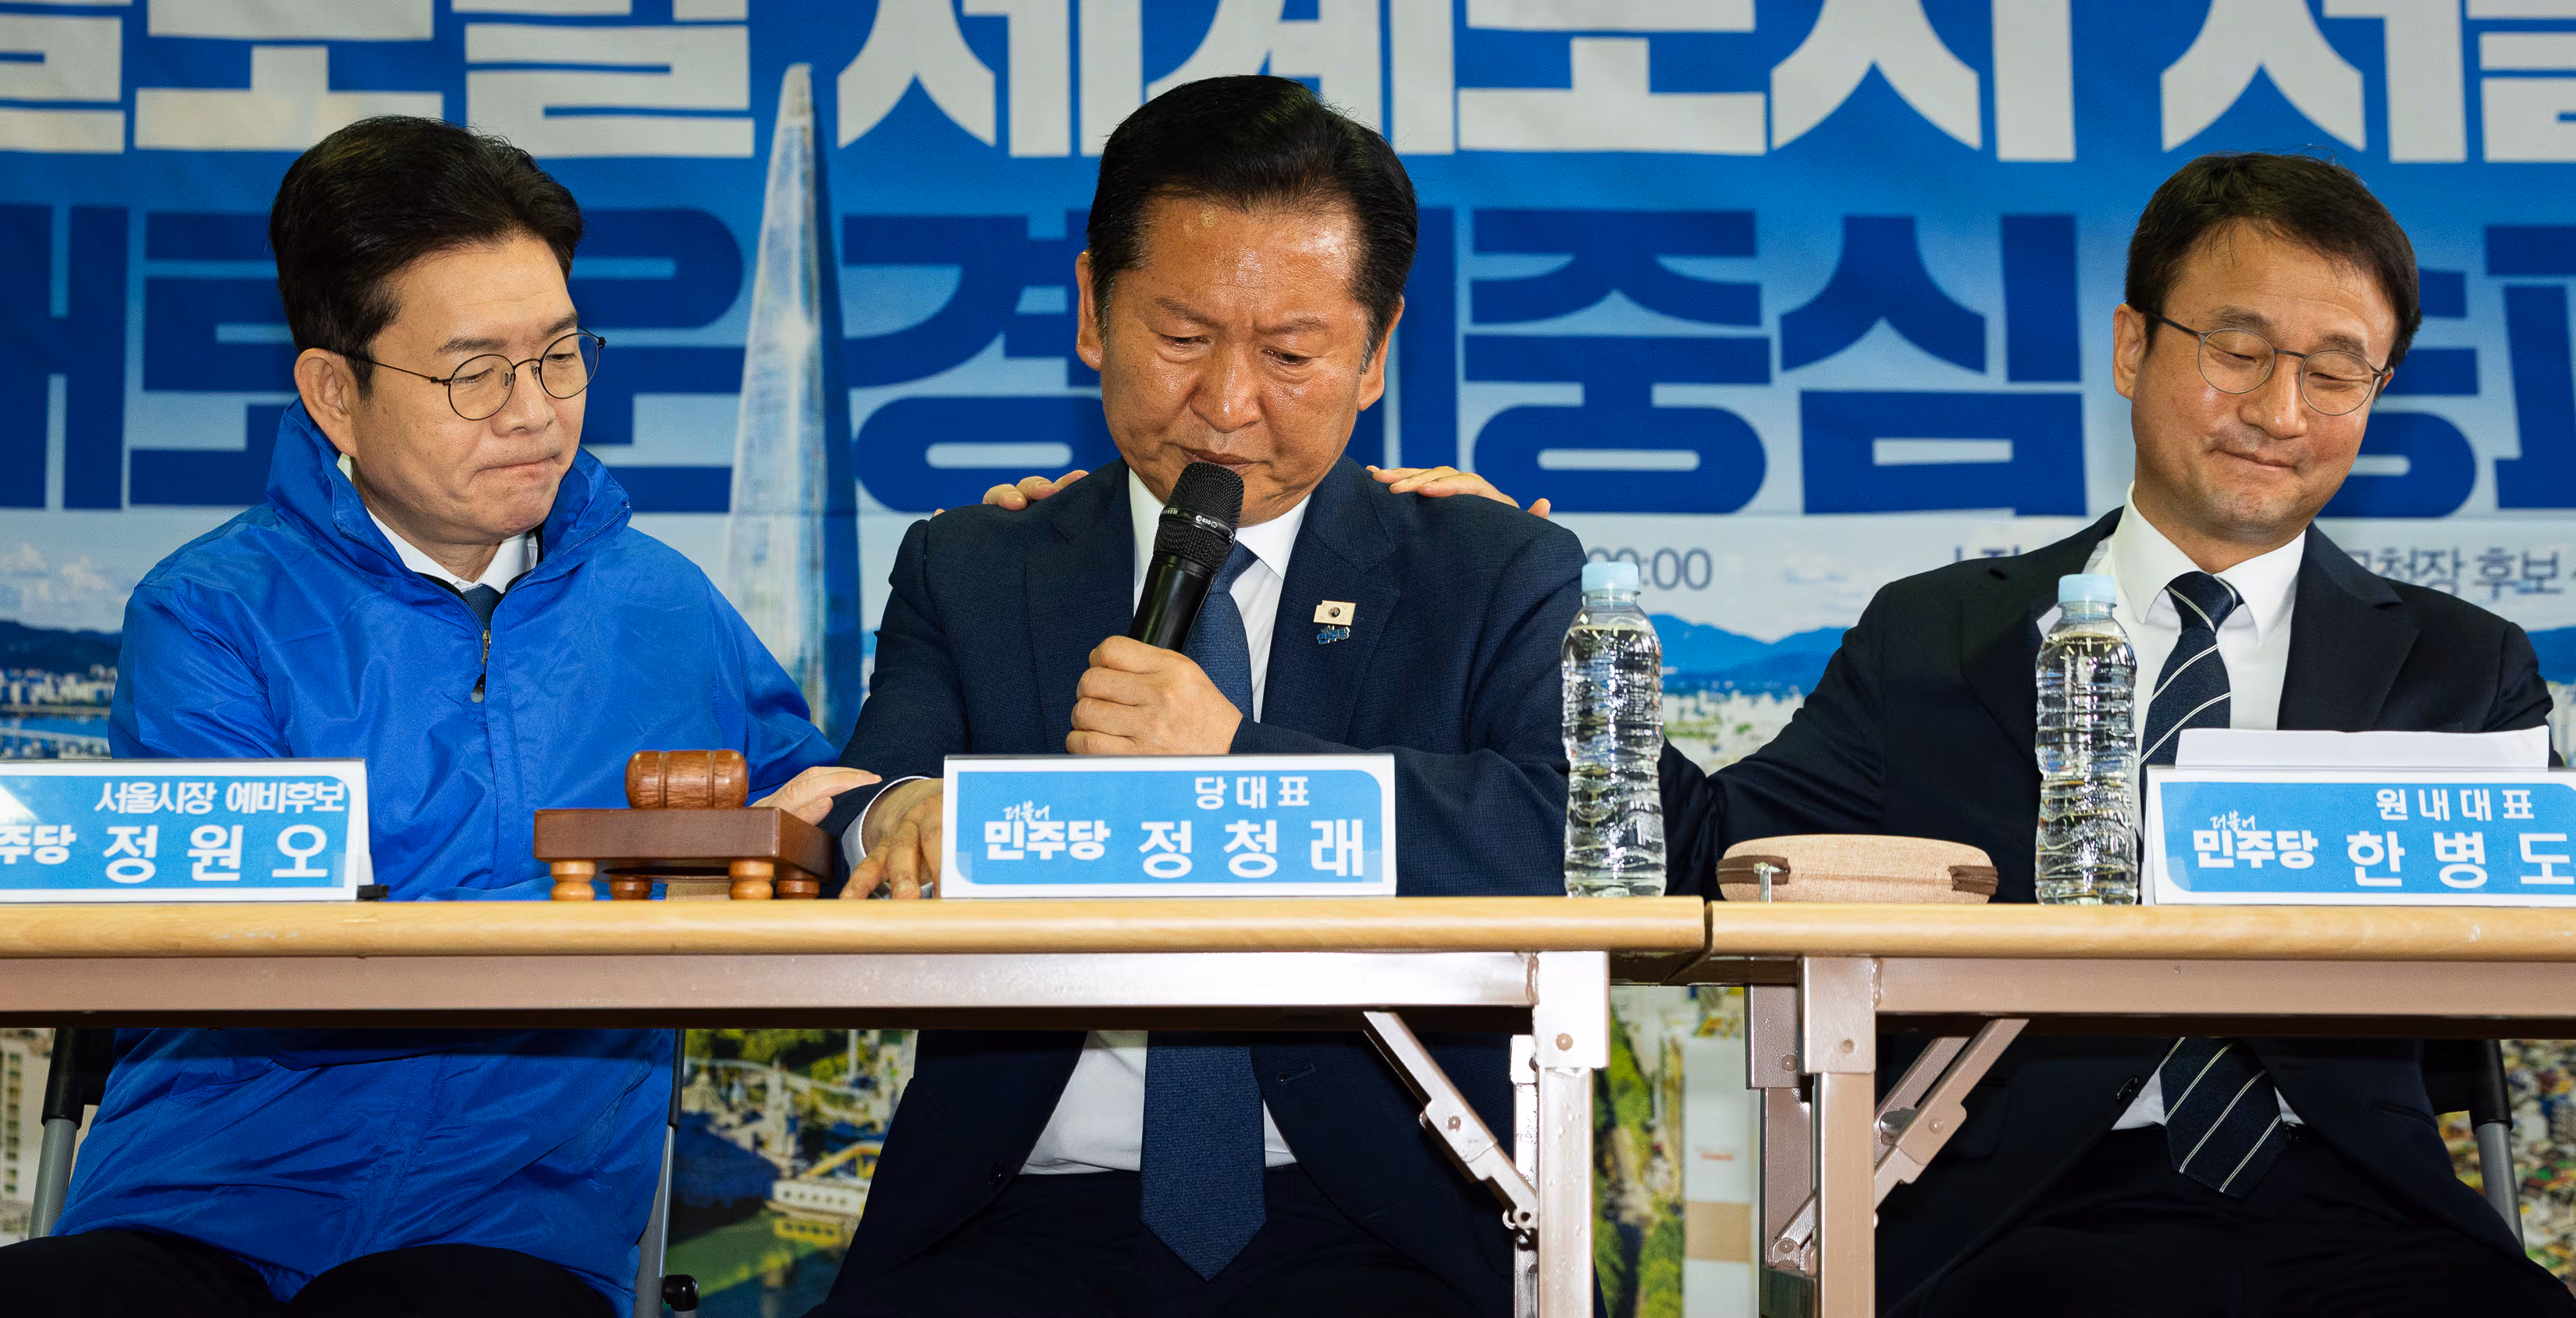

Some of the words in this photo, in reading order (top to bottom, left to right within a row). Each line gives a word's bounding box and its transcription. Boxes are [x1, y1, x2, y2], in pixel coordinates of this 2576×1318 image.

[2473, 547, 2564, 600] 후보
[94, 782, 218, 814] 서울시장
[226, 782, 345, 814] 예비후보
[1003, 800, 1050, 823] 더불어
[2376, 789, 2535, 821] 원내대표
[2210, 810, 2256, 832] 더불어
[984, 819, 1112, 860] 민주당
[2193, 829, 2319, 870] 민주당
